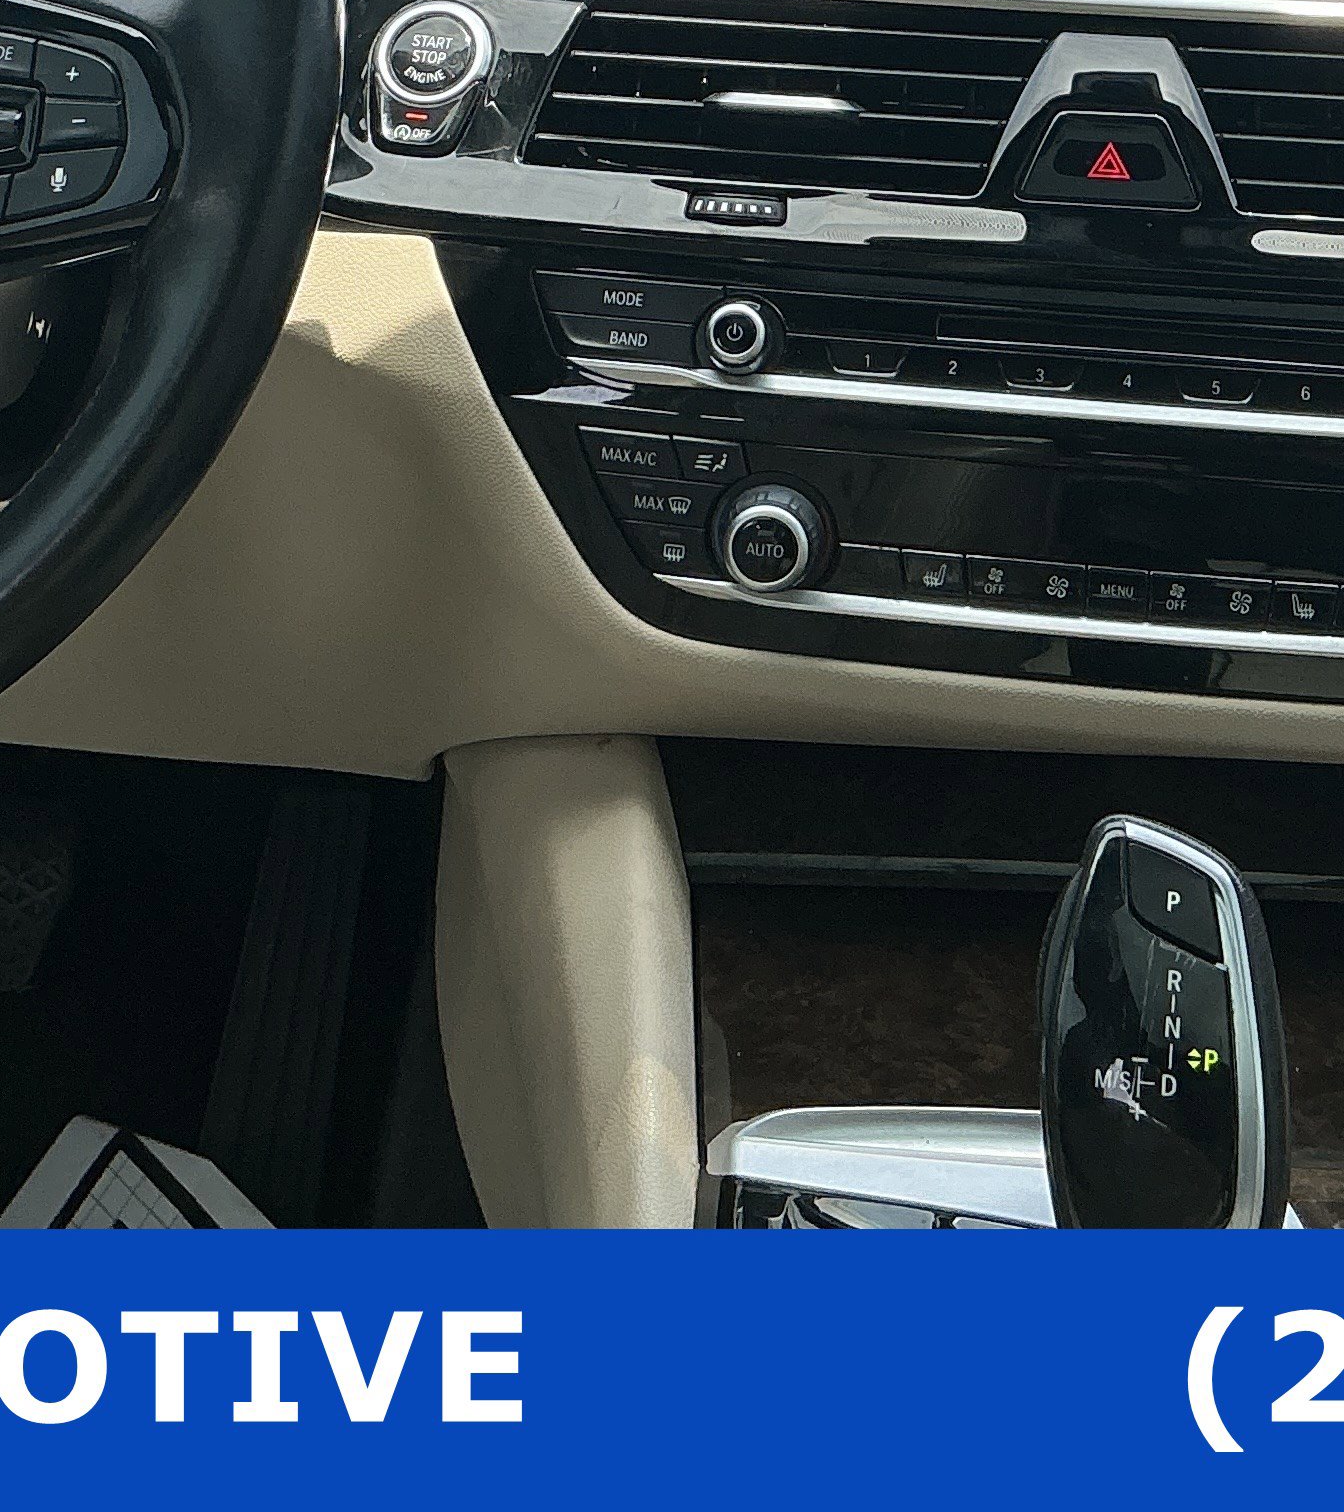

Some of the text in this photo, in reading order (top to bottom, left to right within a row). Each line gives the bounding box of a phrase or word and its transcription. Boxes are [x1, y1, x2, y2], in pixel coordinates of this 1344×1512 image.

[411, 34, 454, 50] START
[411, 49, 447, 64] STOP
[403, 65, 447, 84] ENGINE
[412, 128, 432, 139] OFF
[603, 290, 645, 308] MODE
[608, 330, 648, 348] BAND
[947, 360, 958, 376] 2
[1035, 367, 1045, 383] 3
[1122, 373, 1132, 389] 4
[1211, 380, 1221, 396] 5
[1301, 386, 1311, 402] 6
[601, 446, 657, 467] MAX A/C
[633, 494, 665, 512] MAX
[745, 541, 785, 560] AUTO
[984, 580, 1005, 595] OFF
[1100, 583, 1135, 599] MENU
[1166, 598, 1187, 612] OFF
[1166, 891, 1181, 913] P
[1167, 970, 1182, 993] R
[1164, 1015, 1181, 1039] N
[1204, 1049, 1219, 1072] P
[1160, 1074, 1177, 1098] D
